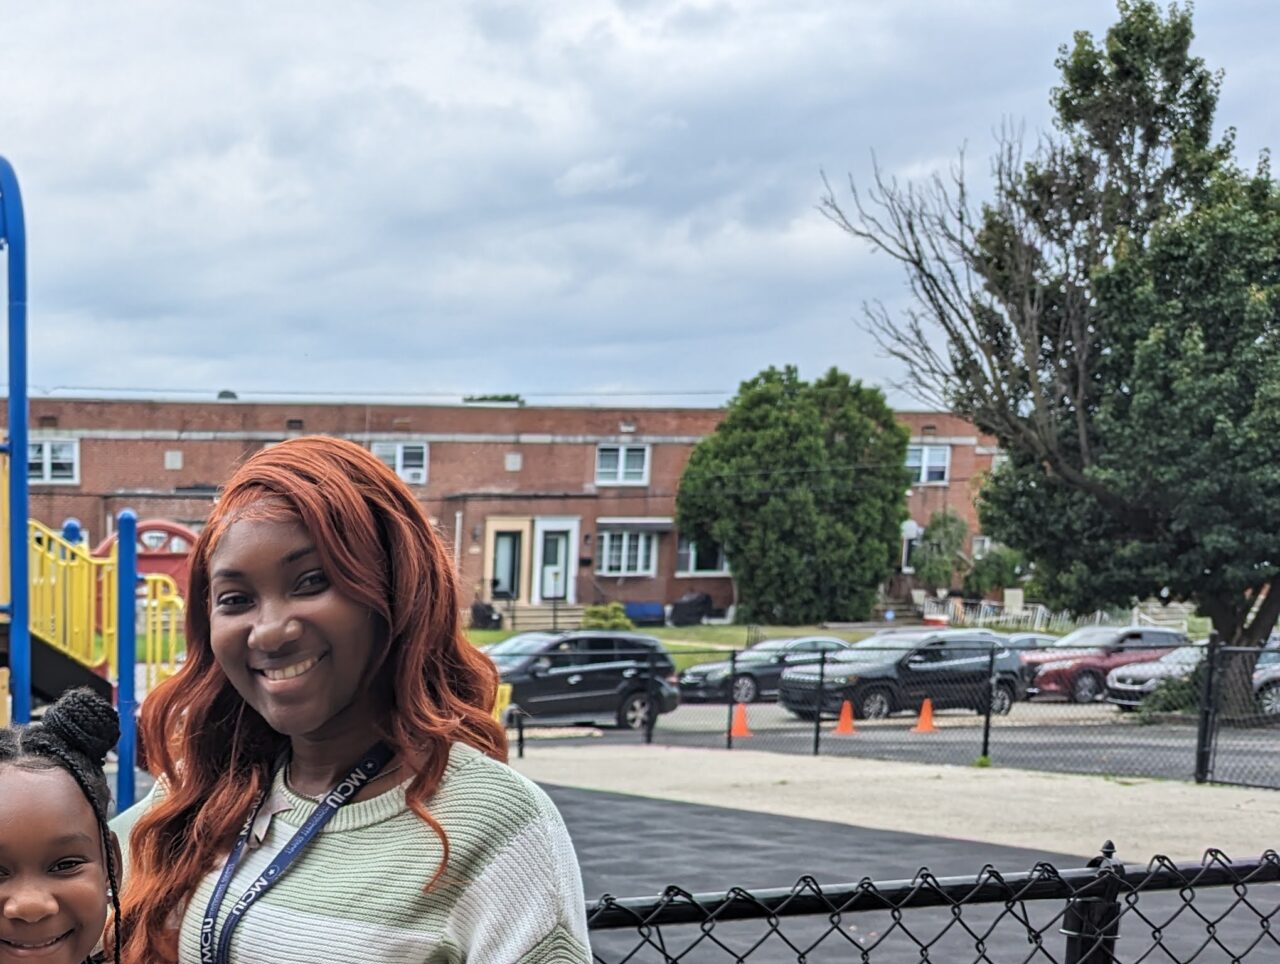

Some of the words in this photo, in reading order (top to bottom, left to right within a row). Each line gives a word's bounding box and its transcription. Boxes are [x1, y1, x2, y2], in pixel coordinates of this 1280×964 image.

[326, 768, 367, 808] MCIU
[232, 877, 268, 915] MCIU
[201, 918, 213, 963] MCIU
